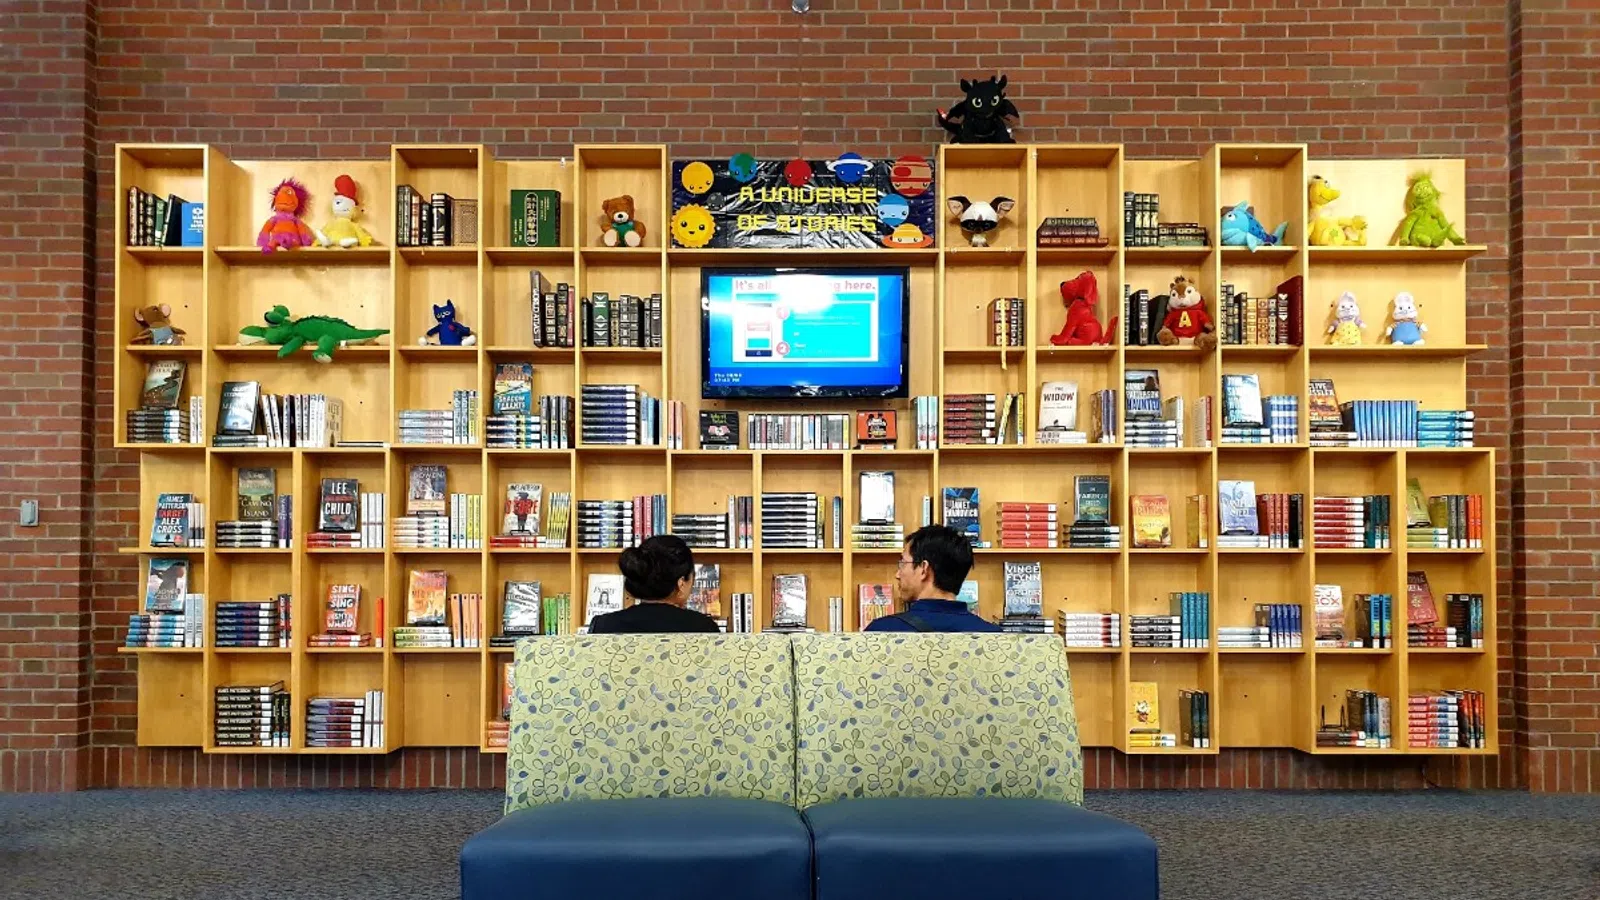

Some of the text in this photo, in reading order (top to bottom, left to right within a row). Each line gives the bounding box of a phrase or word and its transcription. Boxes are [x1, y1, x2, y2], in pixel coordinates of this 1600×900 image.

[740, 186, 877, 204] A UNIVERSE
[737, 214, 877, 232] OF STORIES
[844, 280, 876, 290] here.
[1178, 310, 1192, 328] A
[1043, 392, 1075, 402] WIDOW
[331, 482, 348, 495] LEE
[325, 502, 351, 515] CHILD
[156, 525, 183, 534] CROSS
[1005, 565, 1040, 573] VINCE
[331, 585, 356, 594] SING
[329, 598, 354, 608] SING
